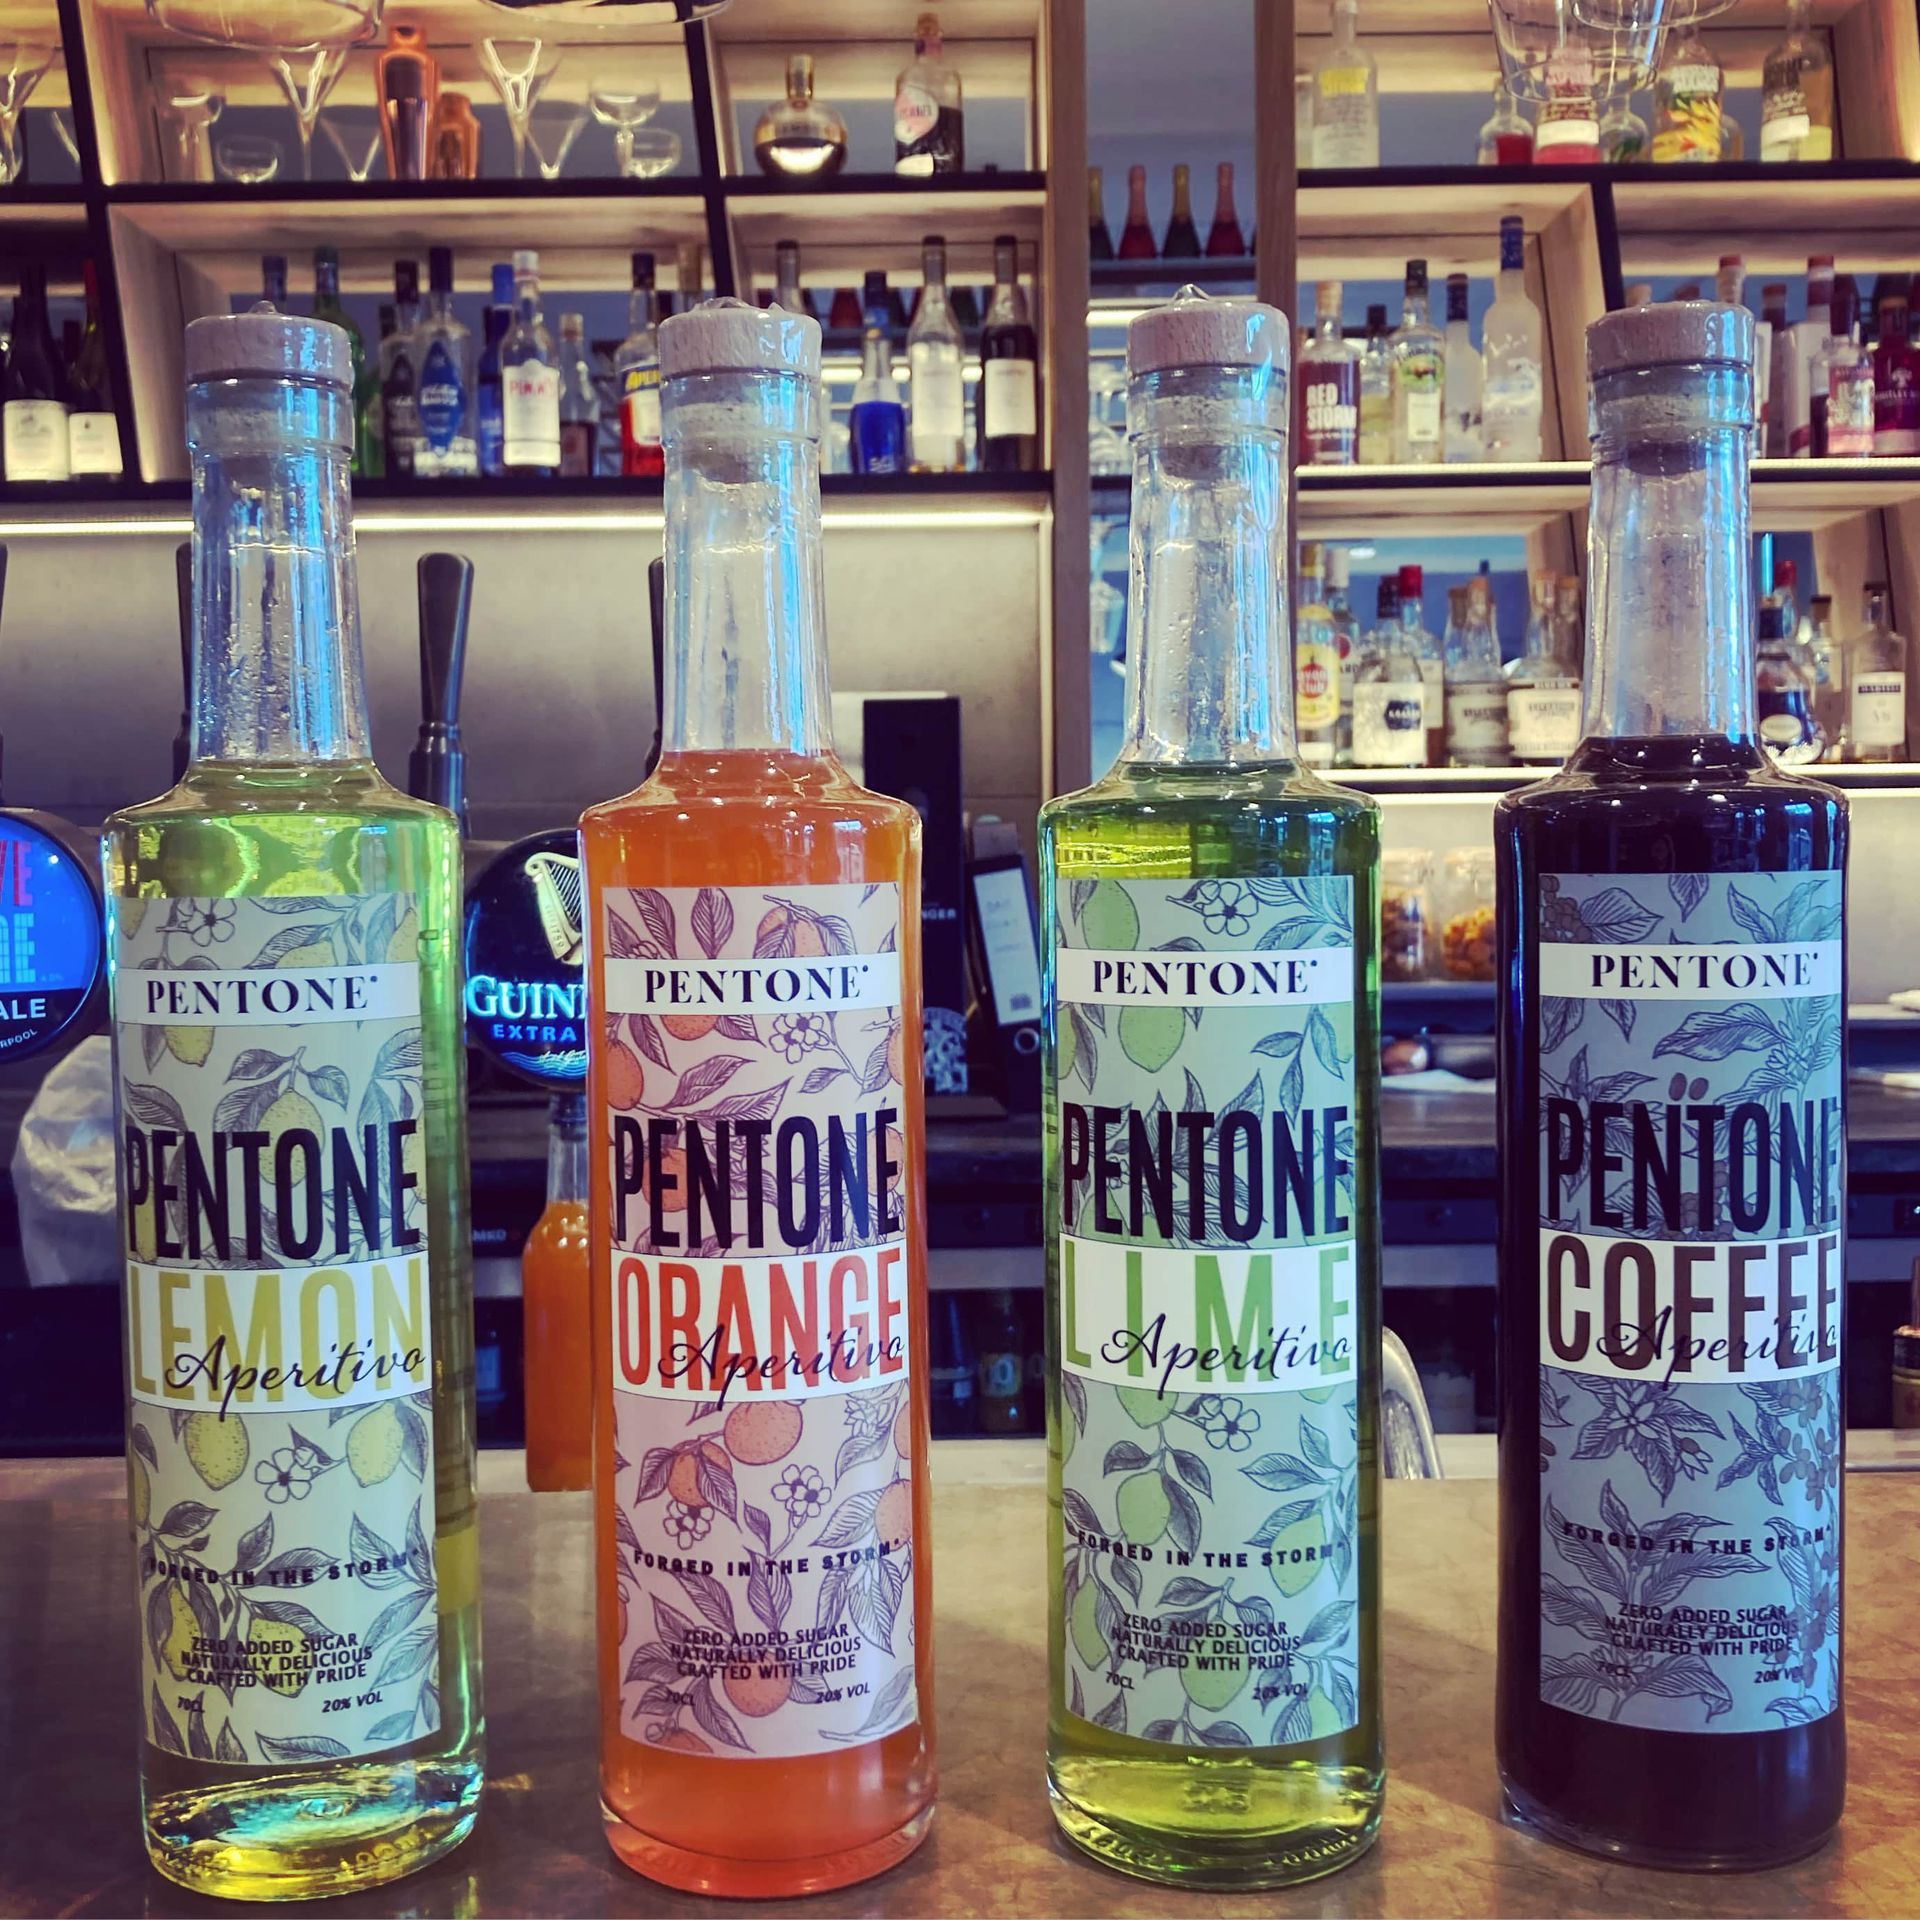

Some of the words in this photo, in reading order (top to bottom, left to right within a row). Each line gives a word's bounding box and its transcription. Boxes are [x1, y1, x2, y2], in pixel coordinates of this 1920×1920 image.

[1306, 383, 1338, 406] RED
[1306, 405, 1357, 430] STORM
[644, 965, 860, 1003] PENTONE
[1093, 960, 1309, 995] PENTONE
[1591, 952, 1819, 988] PENTONE
[147, 975, 367, 1014] PENTONE
[493, 1023, 577, 1042] EXTRA
[1063, 1101, 1349, 1241] PENTONE
[1547, 1096, 1837, 1232] PENTONE
[126, 1119, 420, 1260] PENTONE
[614, 1108, 899, 1249] PENTONE
[1065, 1239, 1350, 1382] LIME
[1548, 1234, 1838, 1373] COFFEE
[130, 1258, 424, 1403] LEMON
[618, 1247, 903, 1392] ORANGE
[658, 1324, 905, 1411] Aperitivo
[1101, 1313, 1352, 1400] Aperitivo
[165, 1335, 425, 1422] Aperitivo
[1077, 1529, 1153, 1561] FORGED
[1167, 1551, 1190, 1566] IN
[1204, 1553, 1248, 1568] THE
[1564, 1521, 1654, 1550] FORGED
[1670, 1539, 1693, 1554] IN
[1710, 1539, 1751, 1554] THE
[634, 1550, 713, 1576] FORGED
[727, 1561, 751, 1576] IN
[765, 1558, 809, 1575] THE
[822, 1541, 890, 1570] STORM
[231, 1570, 254, 1586] IN
[269, 1569, 314, 1585] THE
[1122, 1612, 1161, 1633] ZERO
[1169, 1622, 1227, 1638] ADDED
[1234, 1621, 1287, 1638] SUGAR
[1619, 1602, 1662, 1620] ZERO
[1670, 1608, 1730, 1623] ADDED
[1737, 1604, 1786, 1623] SUGAR
[683, 1629, 723, 1646] ZERO
[730, 1631, 788, 1647] ADDED
[796, 1624, 848, 1645] SUGAR
[1111, 1626, 1203, 1654] NATURALLY
[1212, 1636, 1300, 1654] DELICIOUS
[1605, 1616, 1708, 1639] NATURALLY
[1716, 1620, 1799, 1639] DELICIOUS
[192, 1636, 228, 1652] ZERO
[236, 1640, 293, 1655] ADDED
[301, 1633, 358, 1653] SUGAR
[671, 1643, 767, 1664] NATURALLY
[775, 1637, 861, 1662] DELICIOUS
[1118, 1645, 1189, 1669] CRAFTED
[1196, 1655, 1240, 1671] WITH
[1249, 1653, 1295, 1670] PRIDE
[1612, 1632, 1691, 1655] CRAFTED
[1701, 1641, 1743, 1656] WITH
[1750, 1637, 1792, 1654] PRIDE
[181, 1650, 272, 1672] NATURALLY
[279, 1646, 373, 1670] DELICIOUS
[677, 1661, 751, 1680] CRAFTED
[758, 1664, 803, 1680] WITH
[811, 1654, 857, 1675] PRIDE
[187, 1667, 257, 1688] CRAFTED
[263, 1671, 308, 1688] WITH
[316, 1663, 366, 1684] PRIDE
[1105, 1671, 1135, 1690] 70CL
[321, 1698, 352, 1713] 20%
[356, 1691, 383, 1707] VOL
[816, 1688, 842, 1703] 20%
[846, 1682, 871, 1698] VOL
